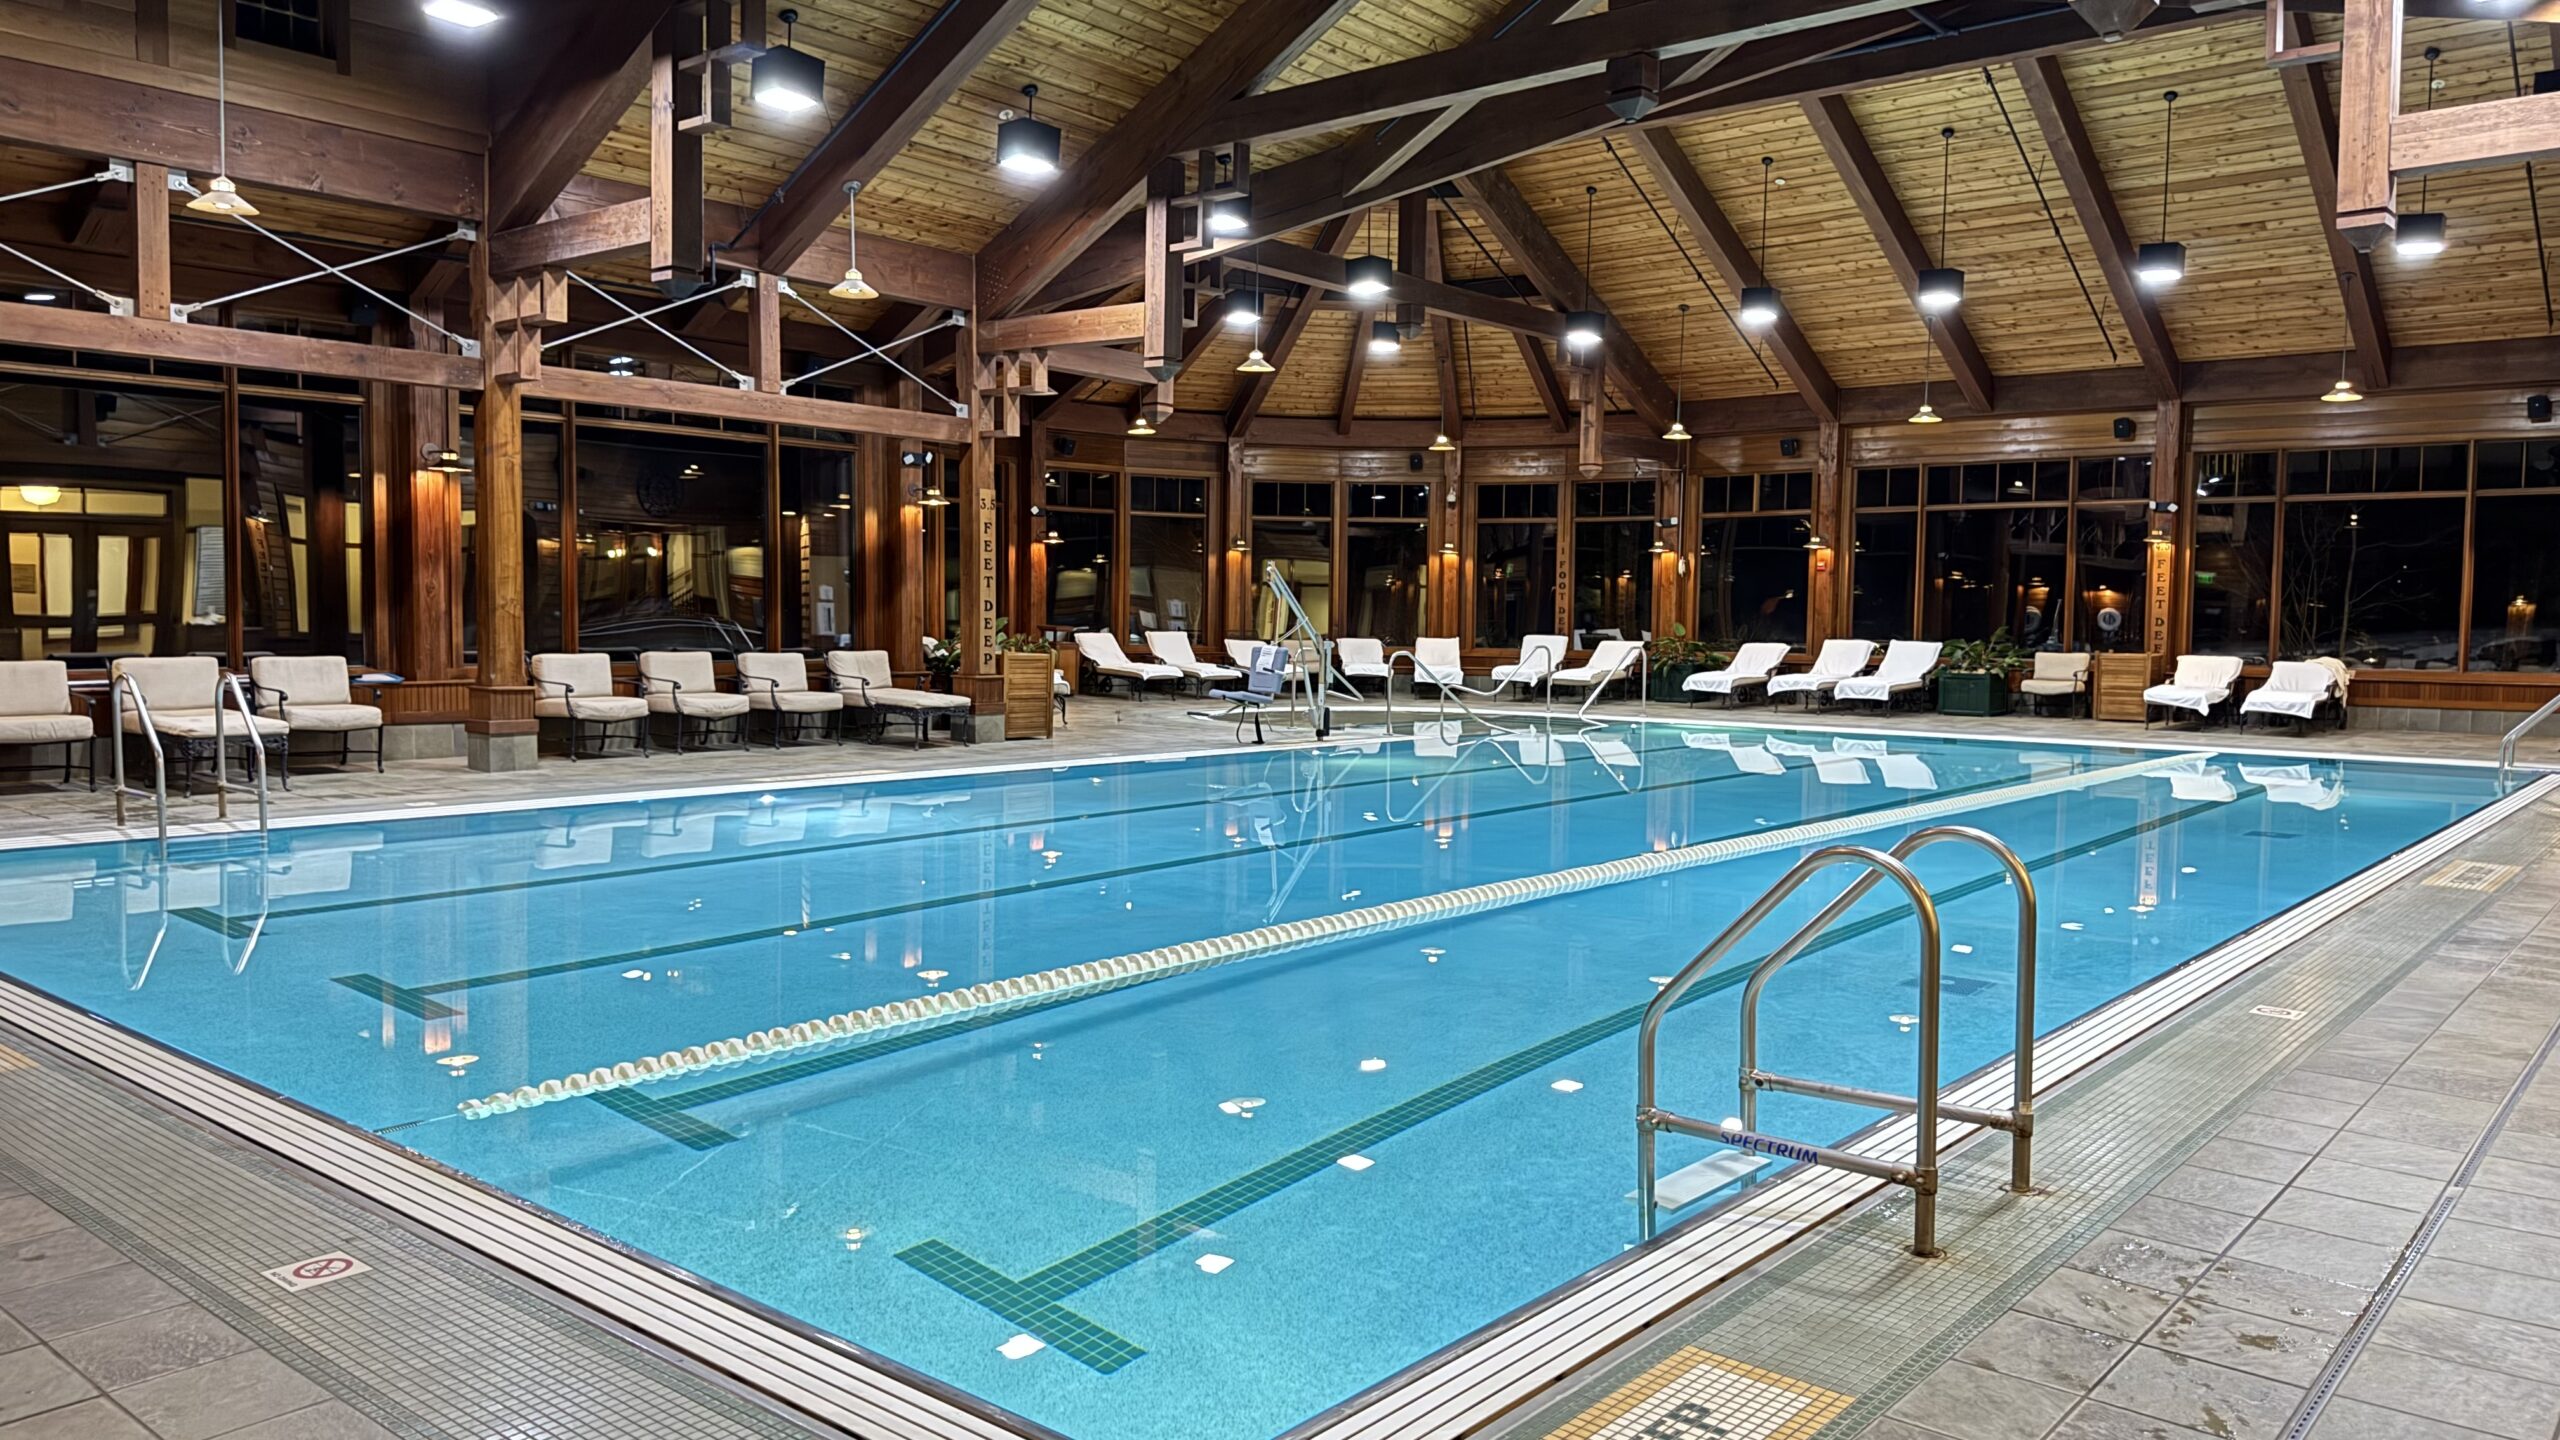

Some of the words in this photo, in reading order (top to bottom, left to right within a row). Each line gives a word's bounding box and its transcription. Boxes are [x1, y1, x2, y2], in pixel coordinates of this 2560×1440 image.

[980, 498, 996, 510] 3.5
[983, 522, 994, 589] FEET
[1558, 561, 1566, 600] FOOT
[2155, 559, 2166, 609] FEET
[983, 600, 994, 665] DEEP
[1720, 1131, 1819, 1165] SPECTRUM
